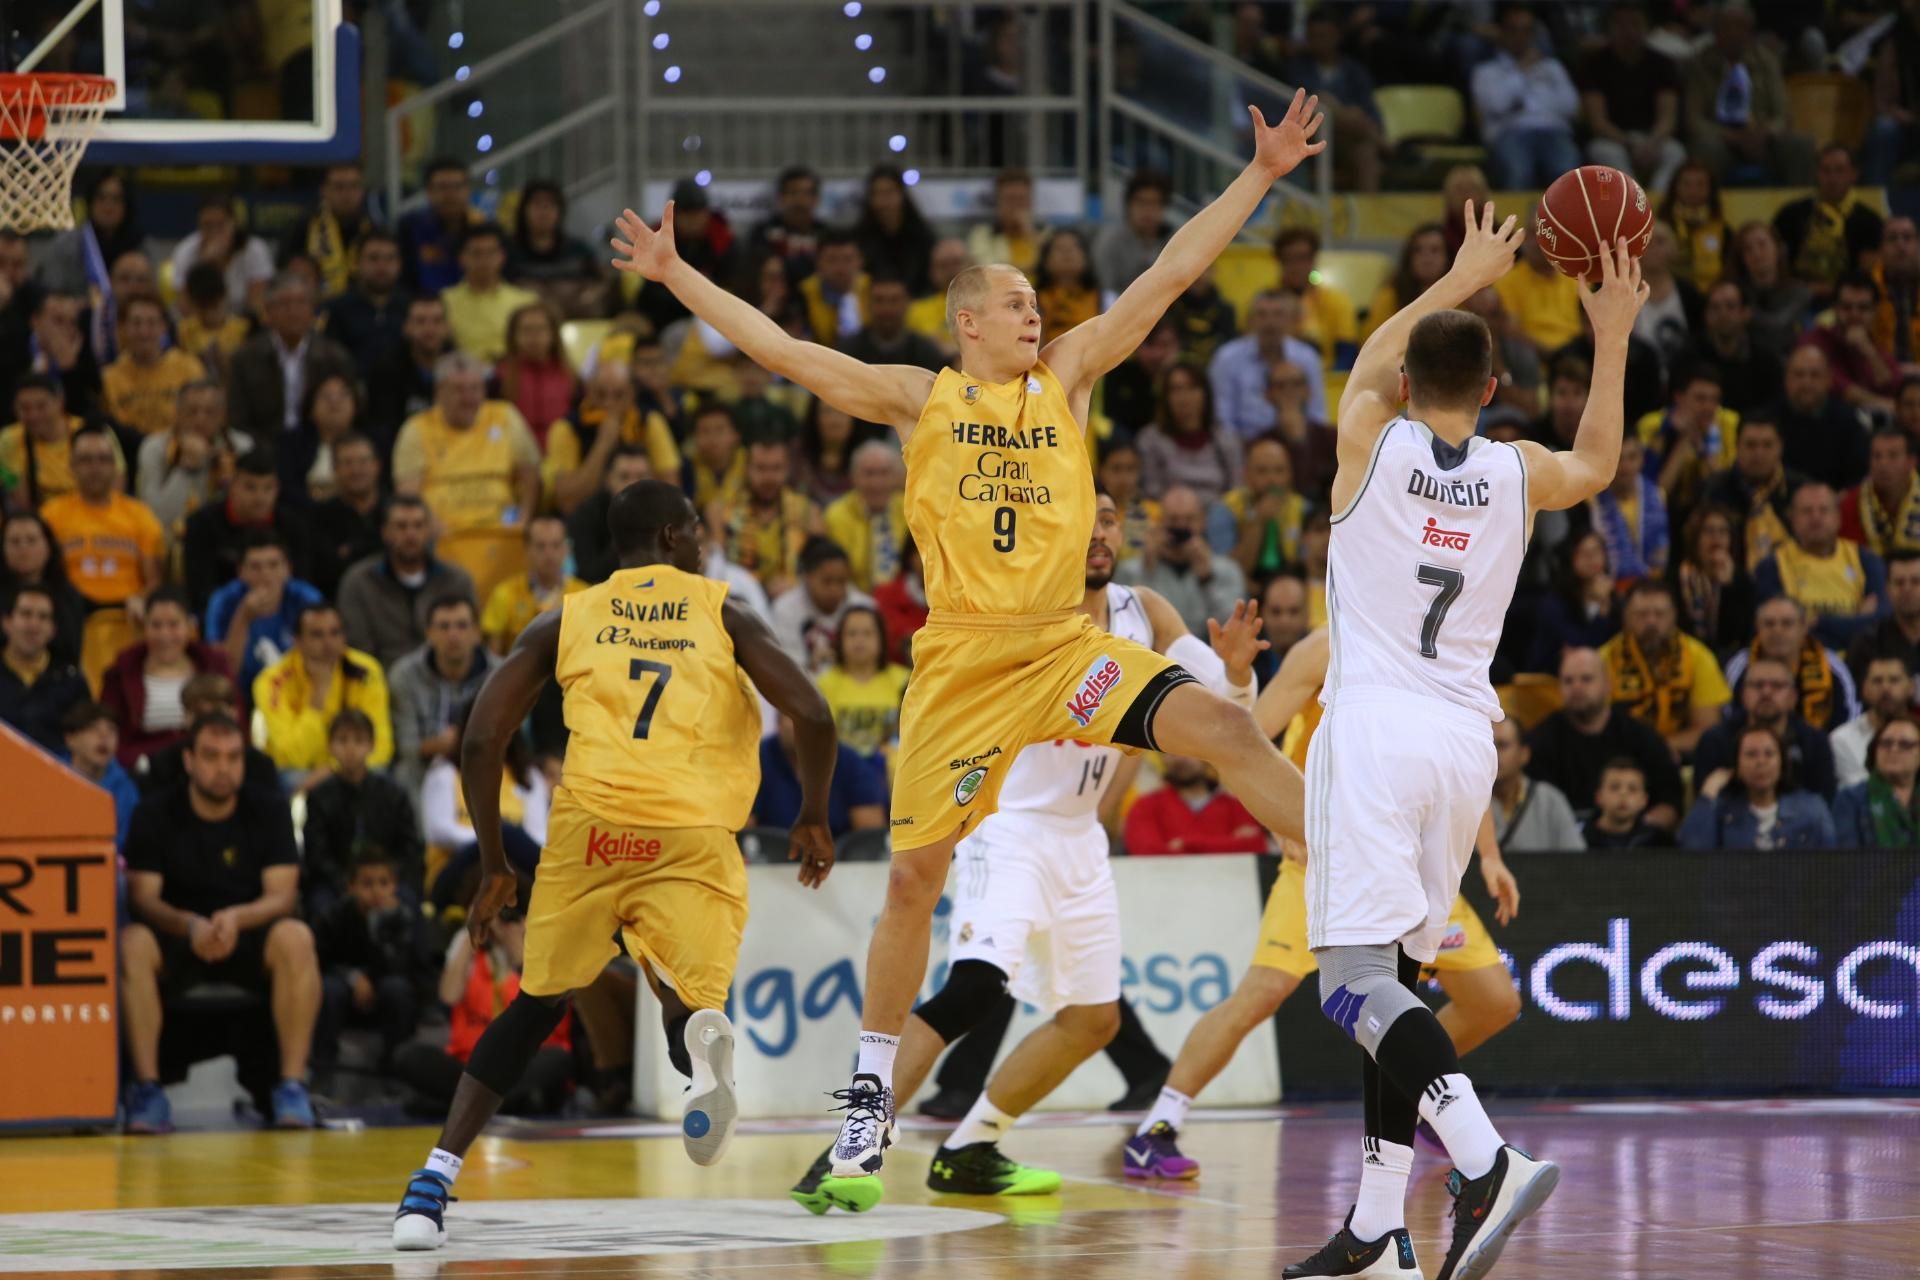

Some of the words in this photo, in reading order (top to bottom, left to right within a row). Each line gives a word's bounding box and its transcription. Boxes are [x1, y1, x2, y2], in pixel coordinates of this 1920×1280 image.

[952, 421, 1058, 450] HERBALFE
[977, 451, 1030, 481] Gran
[958, 473, 1052, 505] Canaria
[992, 506, 1017, 553] 9
[610, 596, 689, 622] SAVANÉ
[1414, 561, 1465, 660] 7
[628, 657, 673, 741] 7
[1066, 660, 1121, 724] Kalise
[1077, 754, 1108, 797] 14
[585, 825, 662, 868] Kalise
